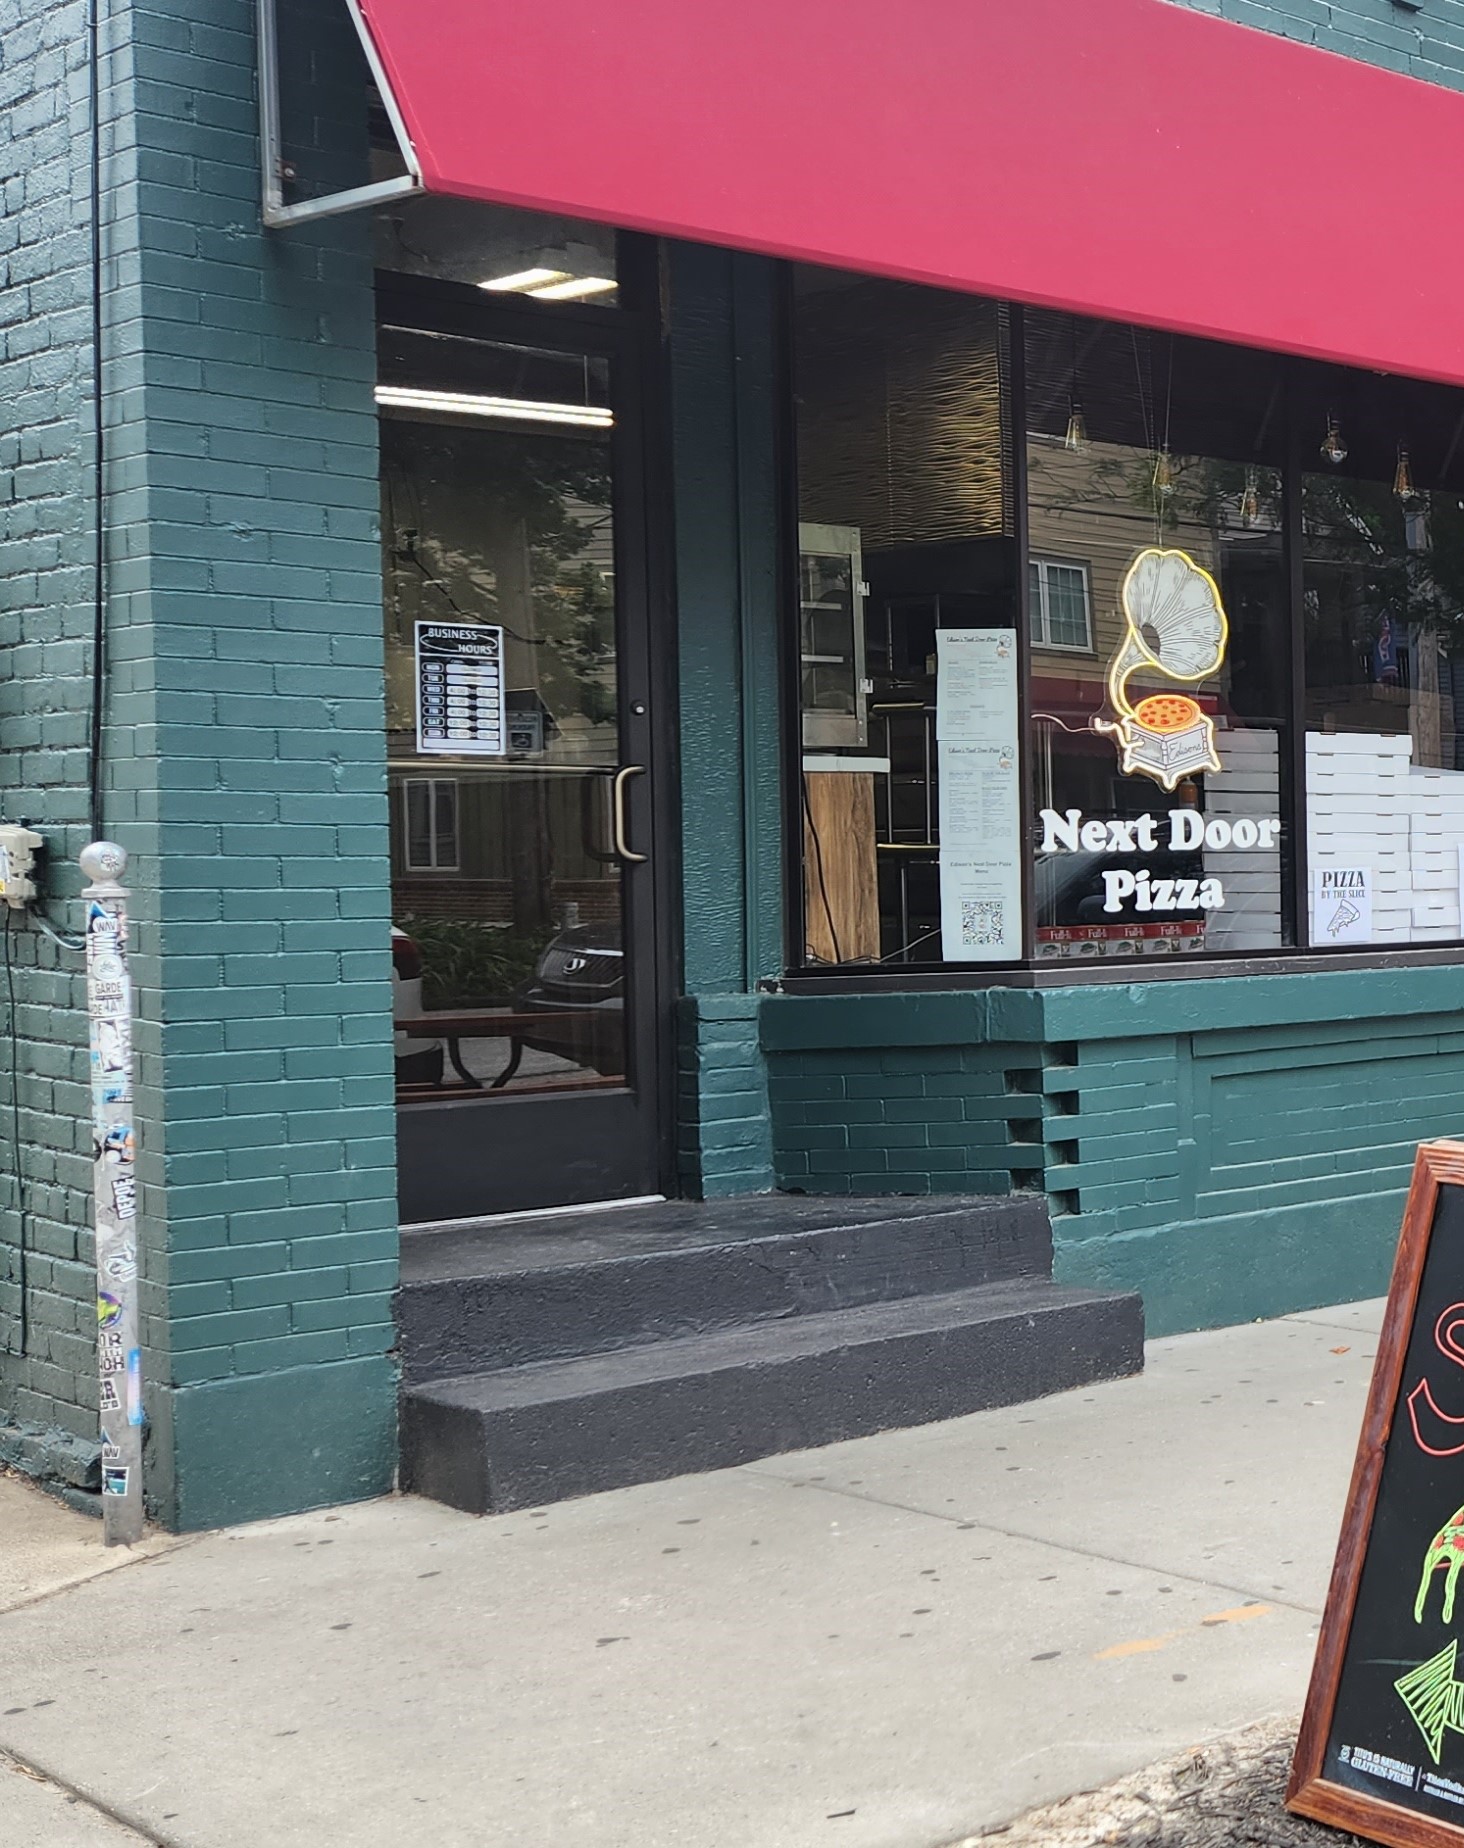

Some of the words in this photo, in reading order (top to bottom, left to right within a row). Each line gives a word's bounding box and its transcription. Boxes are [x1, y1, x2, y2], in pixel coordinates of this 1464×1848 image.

[427, 626, 478, 641] BUSINESS
[457, 643, 493, 655] HOURS
[1039, 808, 1159, 852] Next
[1168, 808, 1281, 851] Door
[1321, 870, 1366, 888] PIZZA
[1101, 869, 1225, 913] Pizza
[1321, 890, 1331, 900] BY
[1333, 889, 1347, 899] THE
[1348, 888, 1366, 899] SLICE
[1350, 1756, 1414, 1788] GLUTEN-FREE
